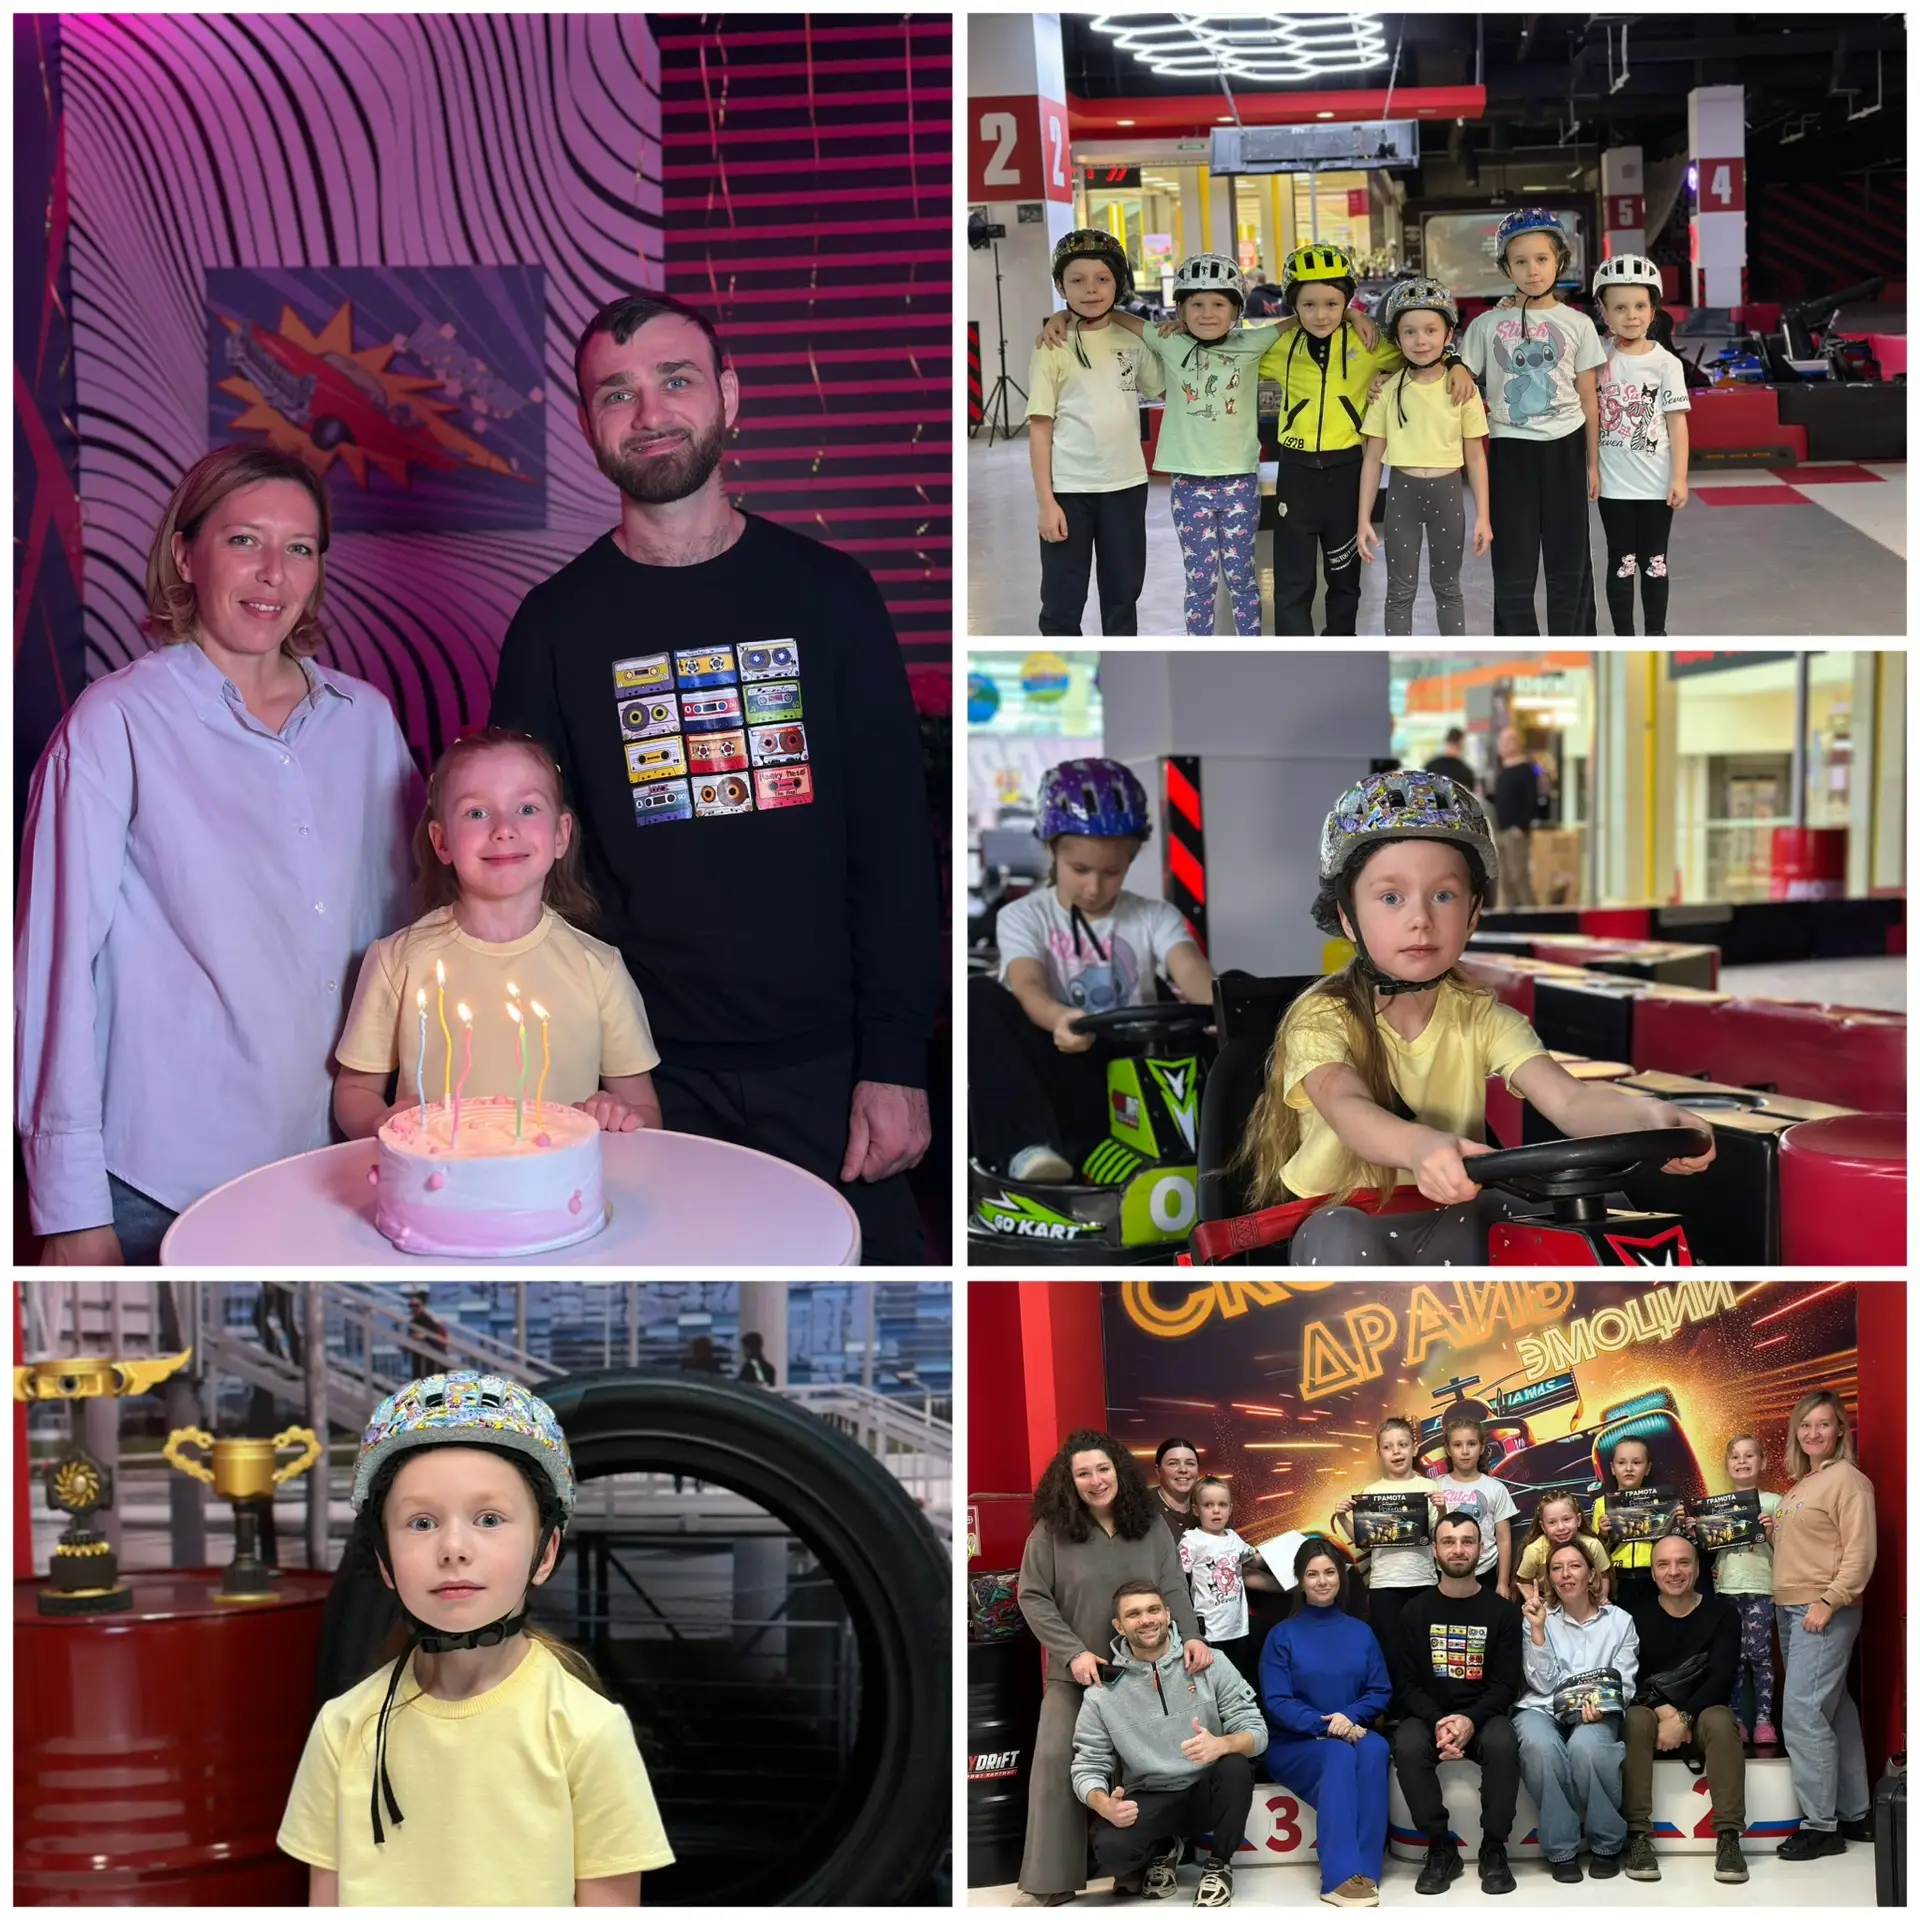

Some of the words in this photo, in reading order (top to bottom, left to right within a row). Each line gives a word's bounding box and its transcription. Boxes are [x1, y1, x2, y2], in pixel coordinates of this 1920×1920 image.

[980, 112, 1020, 186] 2
[1049, 115, 1065, 187] 2
[1711, 165, 1732, 205] 4
[1618, 199, 1634, 226] 5
[1495, 319, 1550, 339] Stich
[1662, 390, 1689, 407] Seven
[994, 1214, 1014, 1233] GO
[1017, 1219, 1081, 1241] KART
[1373, 1494, 1406, 1502] ГРАМОТА
[1626, 1488, 1657, 1497] ГРАМОТА
[1706, 1494, 1737, 1505] ГРАМОТА
[1265, 1796, 1302, 1852] 3
